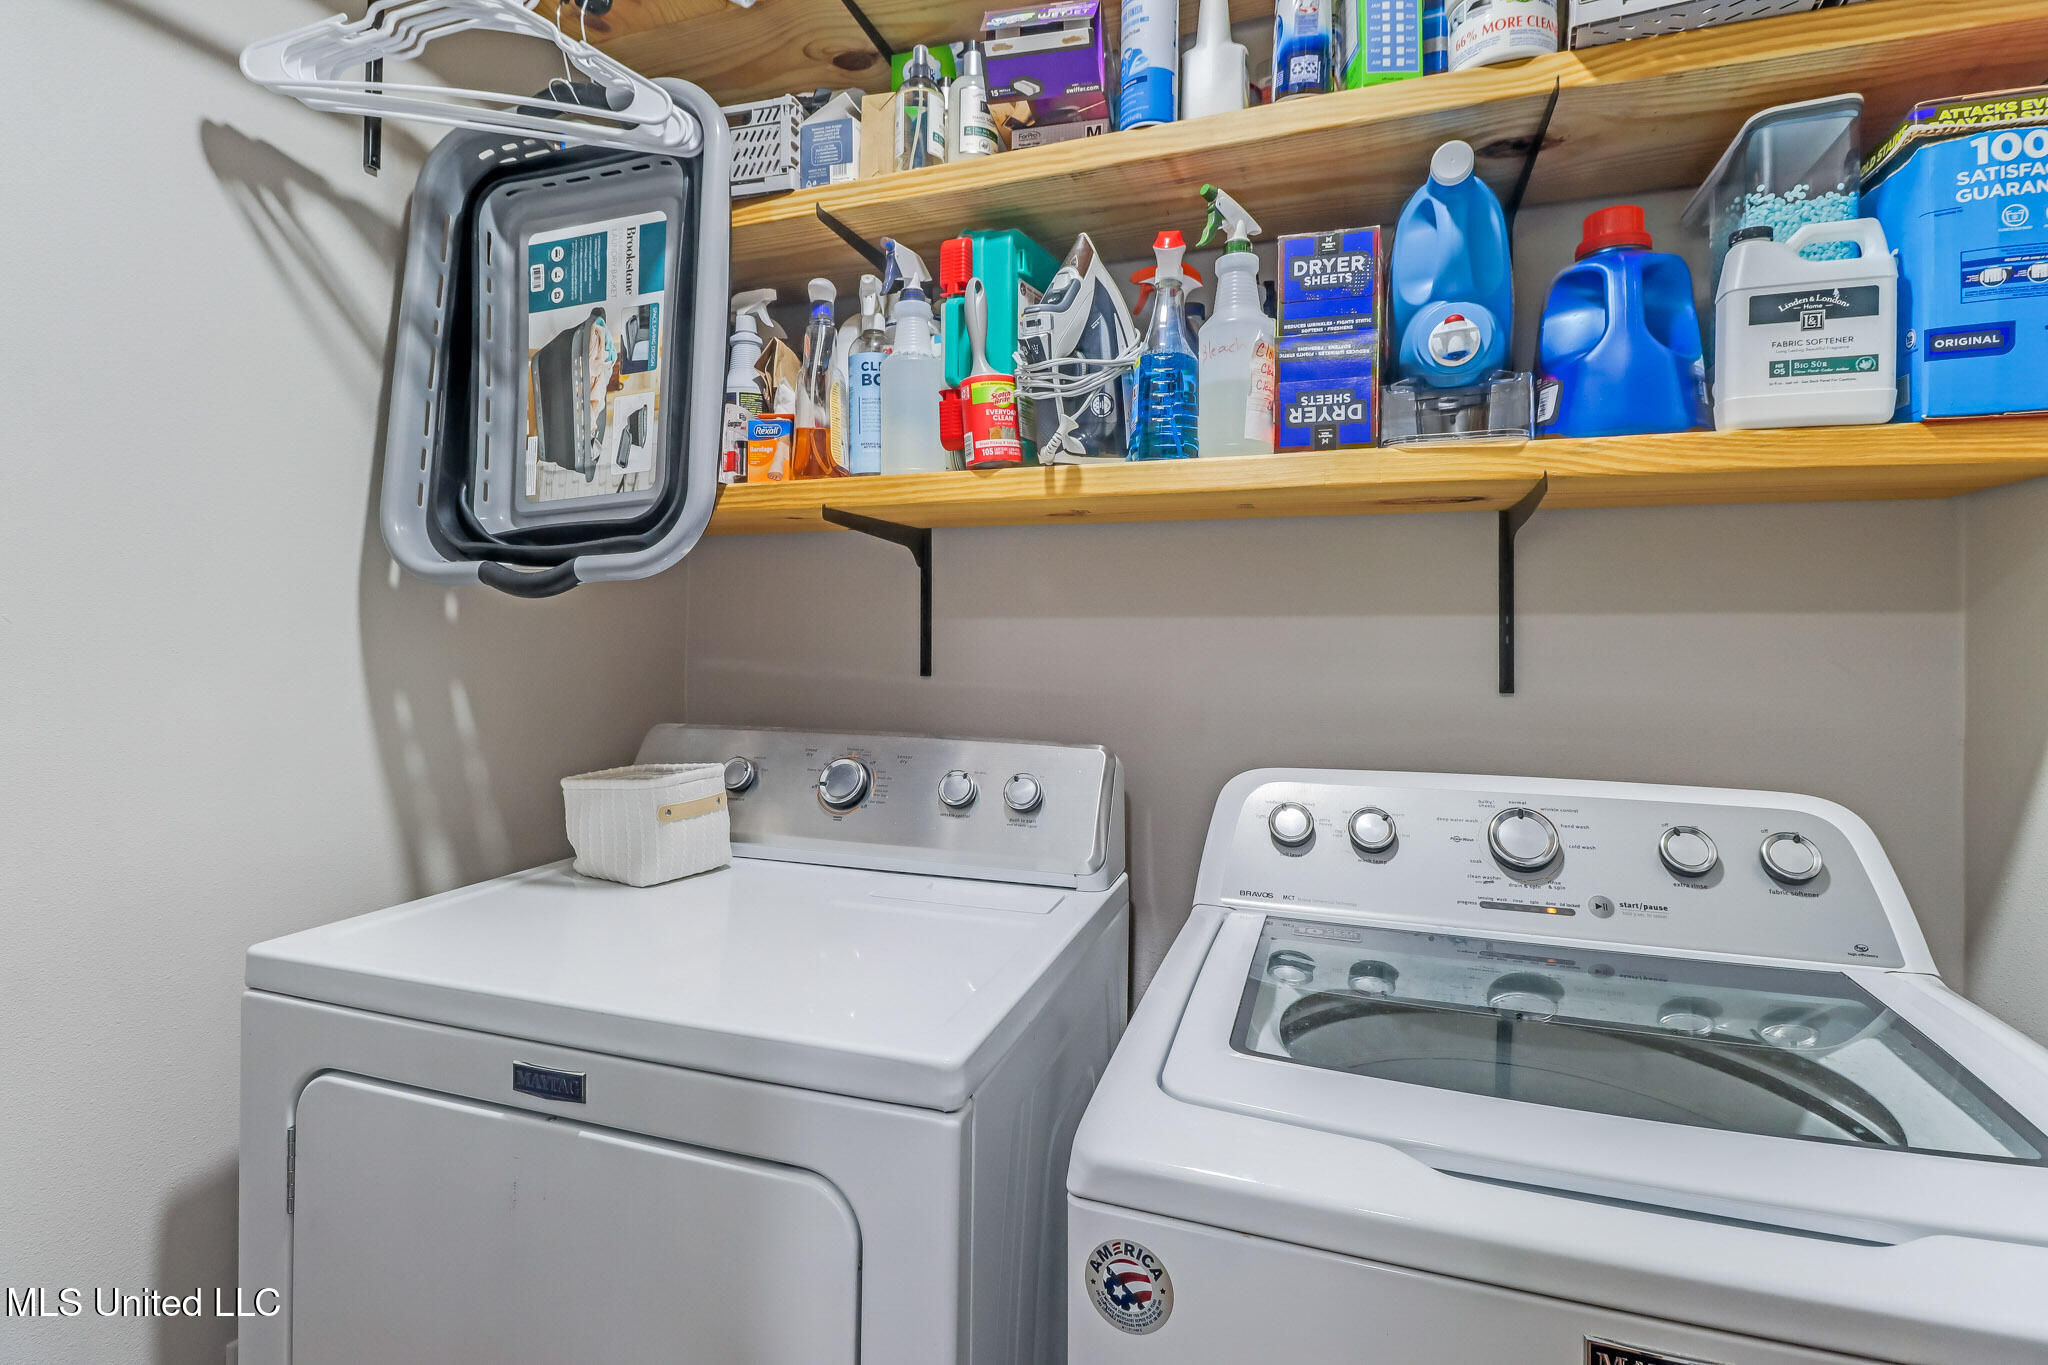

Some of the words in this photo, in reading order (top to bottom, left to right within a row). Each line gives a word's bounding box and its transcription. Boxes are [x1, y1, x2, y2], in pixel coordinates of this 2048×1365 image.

[1455, 29, 1478, 51] 66%
[1481, 15, 1524, 36] MORE
[1065, 85, 1100, 94] swiffer.com
[1939, 101, 2018, 121] ATTACKS
[1086, 125, 1103, 138] M
[1956, 161, 2048, 186] SATISFA
[625, 226, 637, 296] Brookstone
[1293, 255, 1366, 277] DRYER
[1304, 272, 1353, 287] SHEETS
[1777, 296, 1808, 312] Linden
[1808, 295, 1816, 303] &
[1307, 320, 1333, 328] WRINKLES
[1771, 339, 1804, 348] FABRIC
[1805, 335, 1855, 347] SOFTENER
[1934, 334, 2001, 349] ORIGINAL
[1300, 393, 1352, 406] SHEETS
[1288, 403, 1363, 424] DRYER
[755, 426, 780, 435] Rexall
[749, 446, 774, 454] Bandage
[981, 448, 994, 456] 105
[1239, 889, 1274, 899] BRAVOS
[1768, 888, 1789, 896] fabric
[1789, 890, 1820, 898] softener
[1618, 900, 1669, 912] start/pause
[1089, 1241, 1164, 1283] AMERICA
